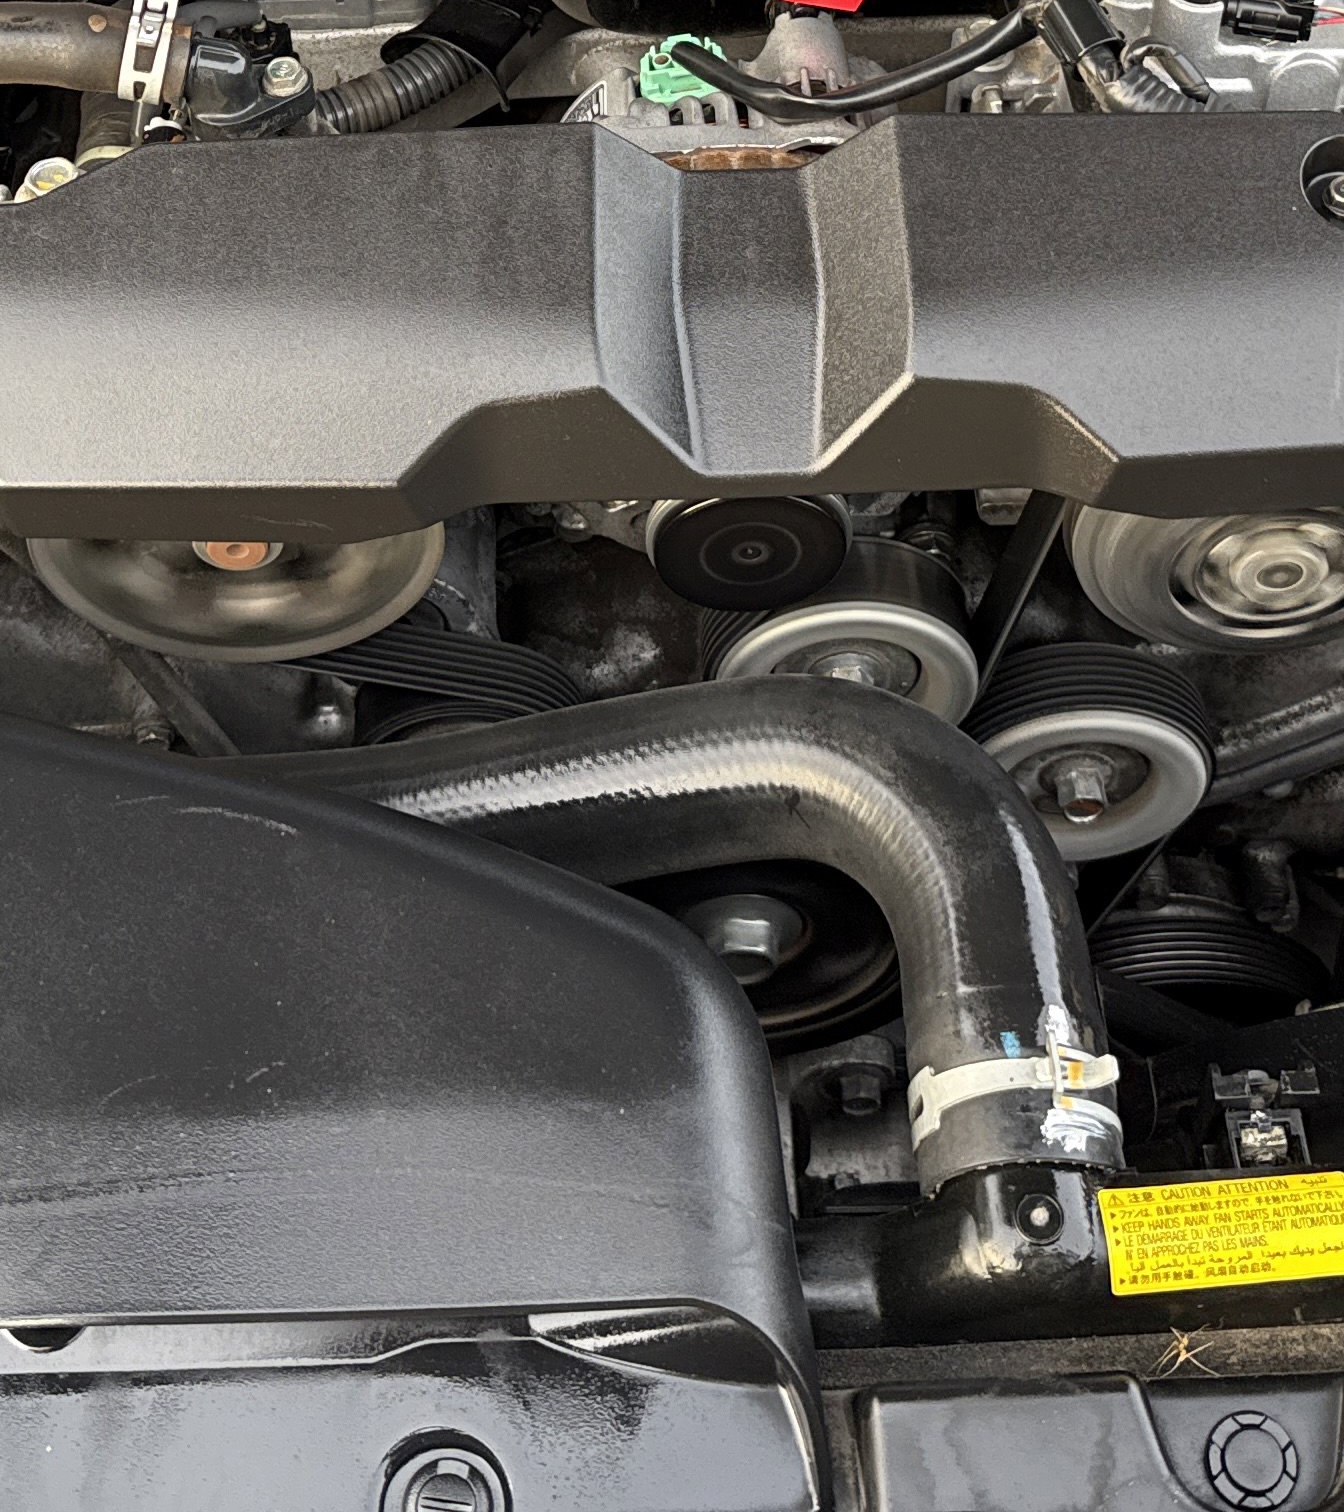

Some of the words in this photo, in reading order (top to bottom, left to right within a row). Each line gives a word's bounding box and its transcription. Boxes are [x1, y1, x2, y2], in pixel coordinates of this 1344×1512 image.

[1160, 1186, 1211, 1201] CAUTION
[1217, 1179, 1289, 1196] ATTENTION
[1127, 1191, 1156, 1204] 注意
[1121, 1221, 1145, 1233] KEEP
[1148, 1217, 1181, 1231] HANDS
[1213, 1212, 1232, 1224] FAN
[1234, 1208, 1270, 1223] STARTS
[1124, 1235, 1134, 1247] LE
[1191, 1228, 1204, 1240] DU
[1206, 1222, 1260, 1239] VENTILATEUR
[1137, 1247, 1148, 1260] EN
[1151, 1241, 1201, 1258] APPROCHEZ
[1202, 1240, 1219, 1252] PAS
[1221, 1238, 1236, 1251] LES
